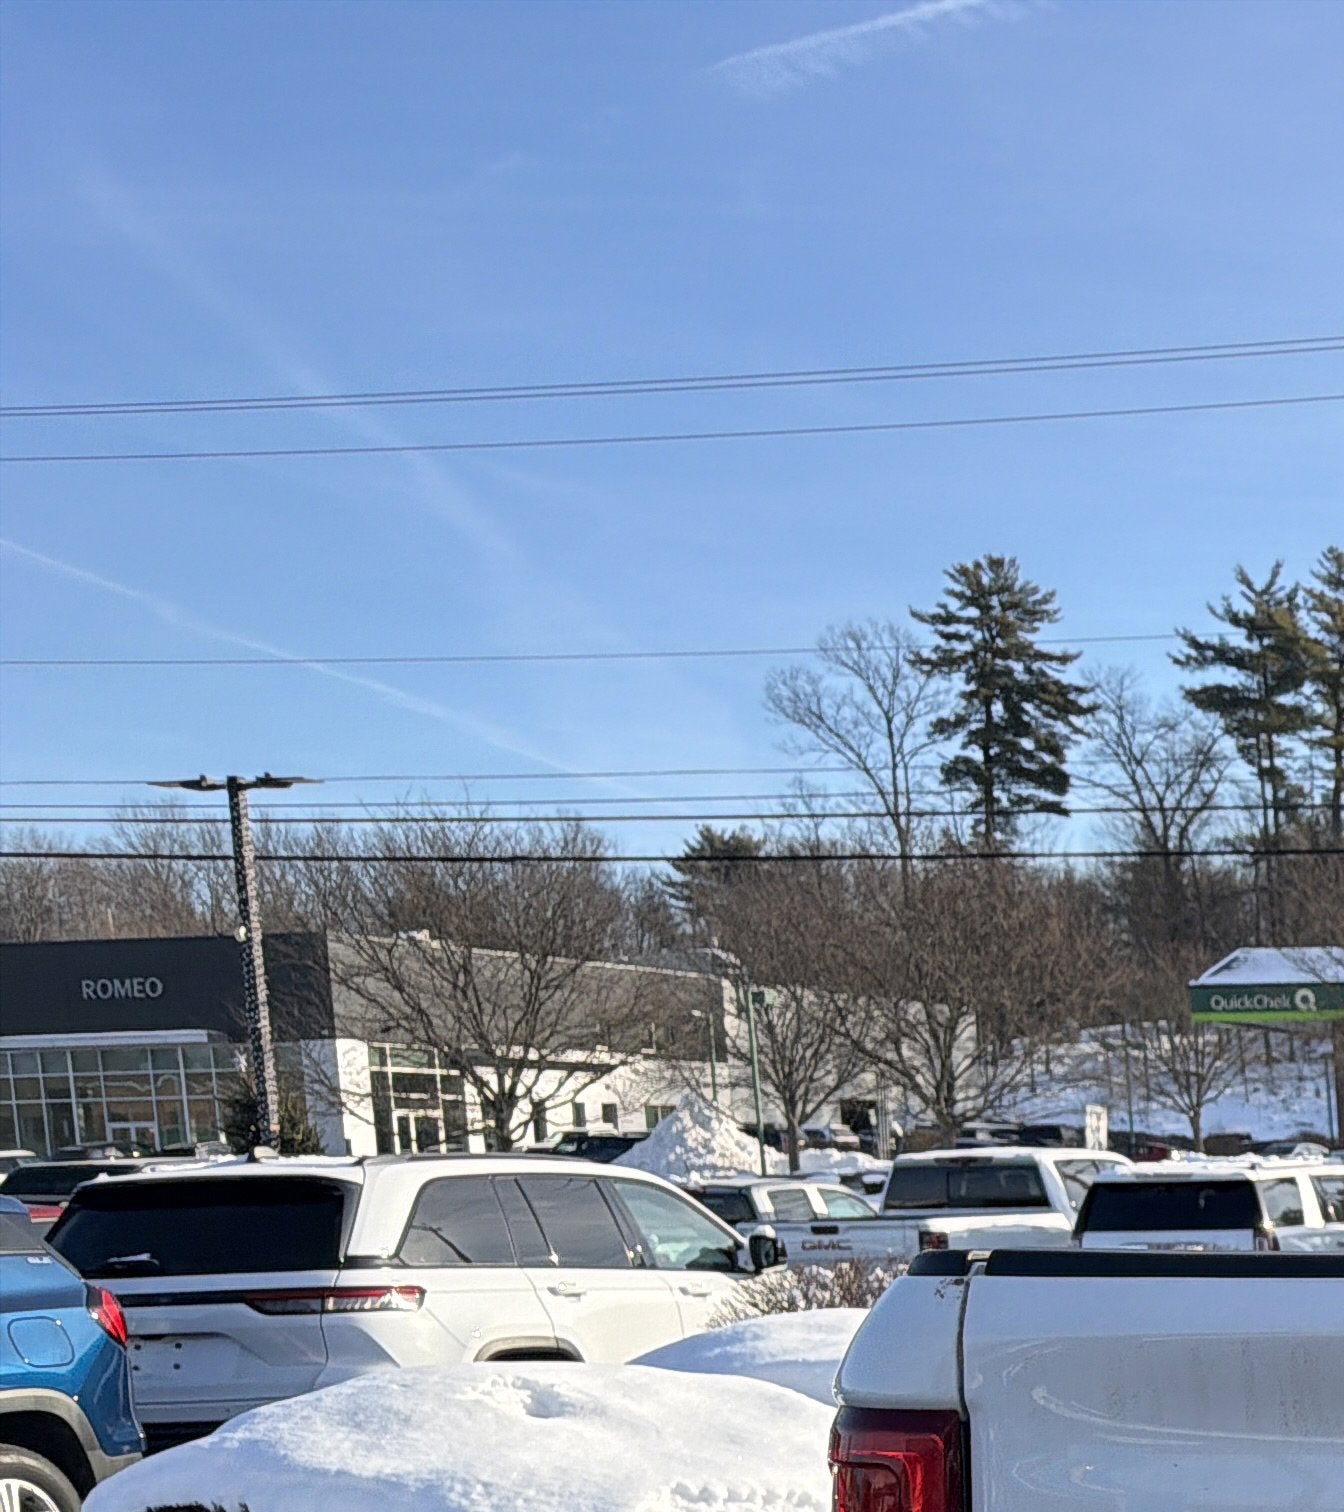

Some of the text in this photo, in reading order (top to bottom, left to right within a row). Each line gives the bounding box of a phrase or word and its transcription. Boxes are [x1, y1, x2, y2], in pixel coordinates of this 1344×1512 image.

[81, 977, 164, 1000] ROMEO
[1210, 994, 1292, 1011] QuickChek
[801, 1239, 853, 1251] GMC
